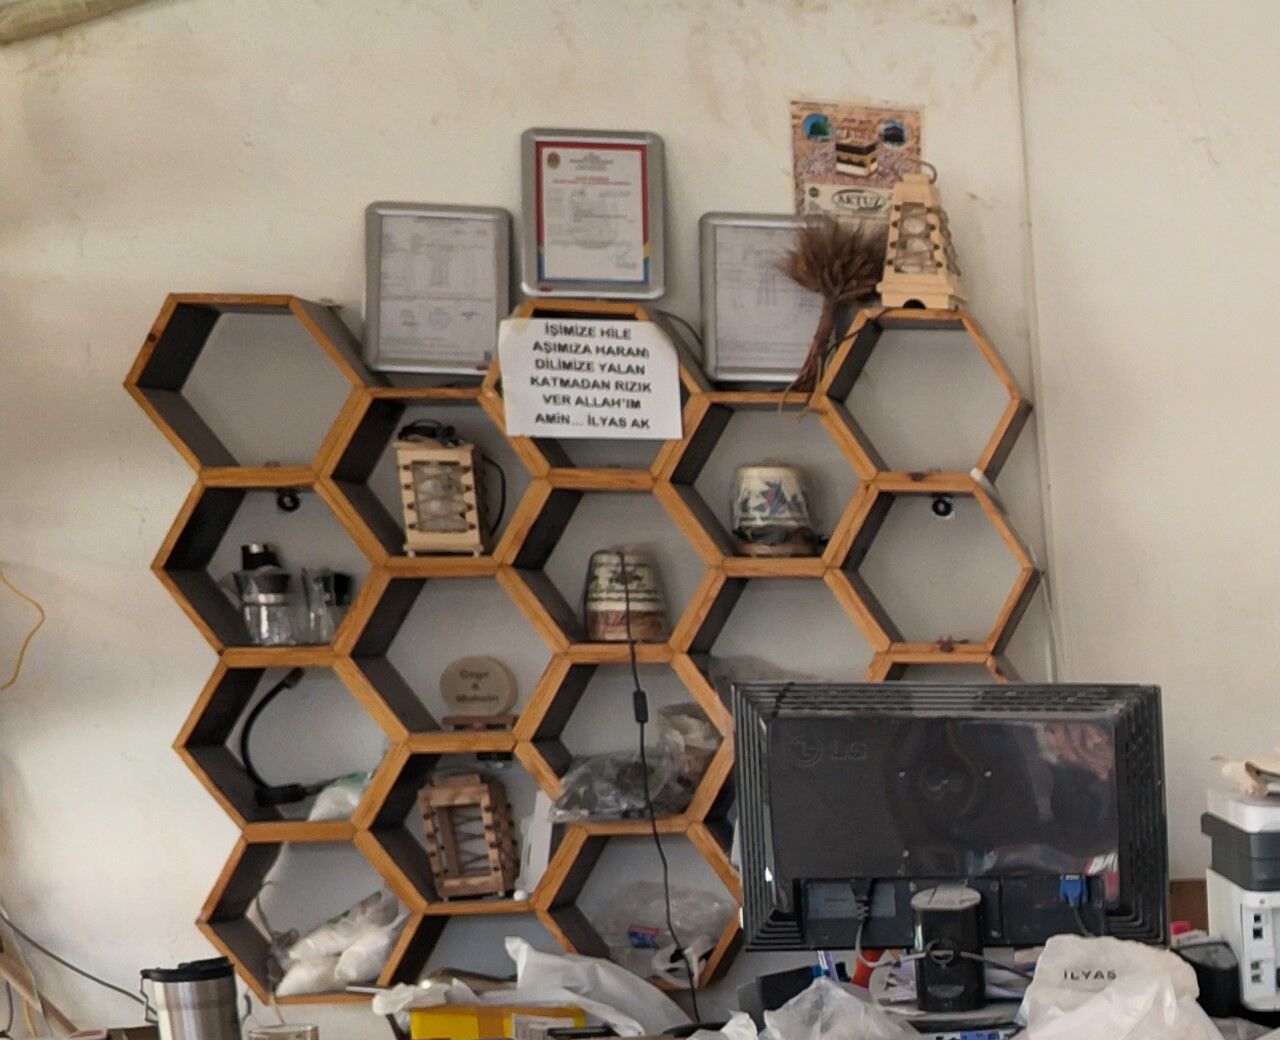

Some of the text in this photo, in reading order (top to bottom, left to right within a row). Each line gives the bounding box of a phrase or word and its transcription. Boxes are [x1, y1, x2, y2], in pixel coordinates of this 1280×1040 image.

[545, 322, 632, 340] İŞİMİZE HİLE
[532, 340, 593, 355] AŞIMIZA
[535, 357, 645, 375] DİLİMİZE YALAN
[530, 376, 652, 392] KATMADAN RIZIK
[542, 394, 641, 409] VER ALLAH'IM
[587, 413, 627, 428] İLYAS
[631, 417, 650, 429] AK
